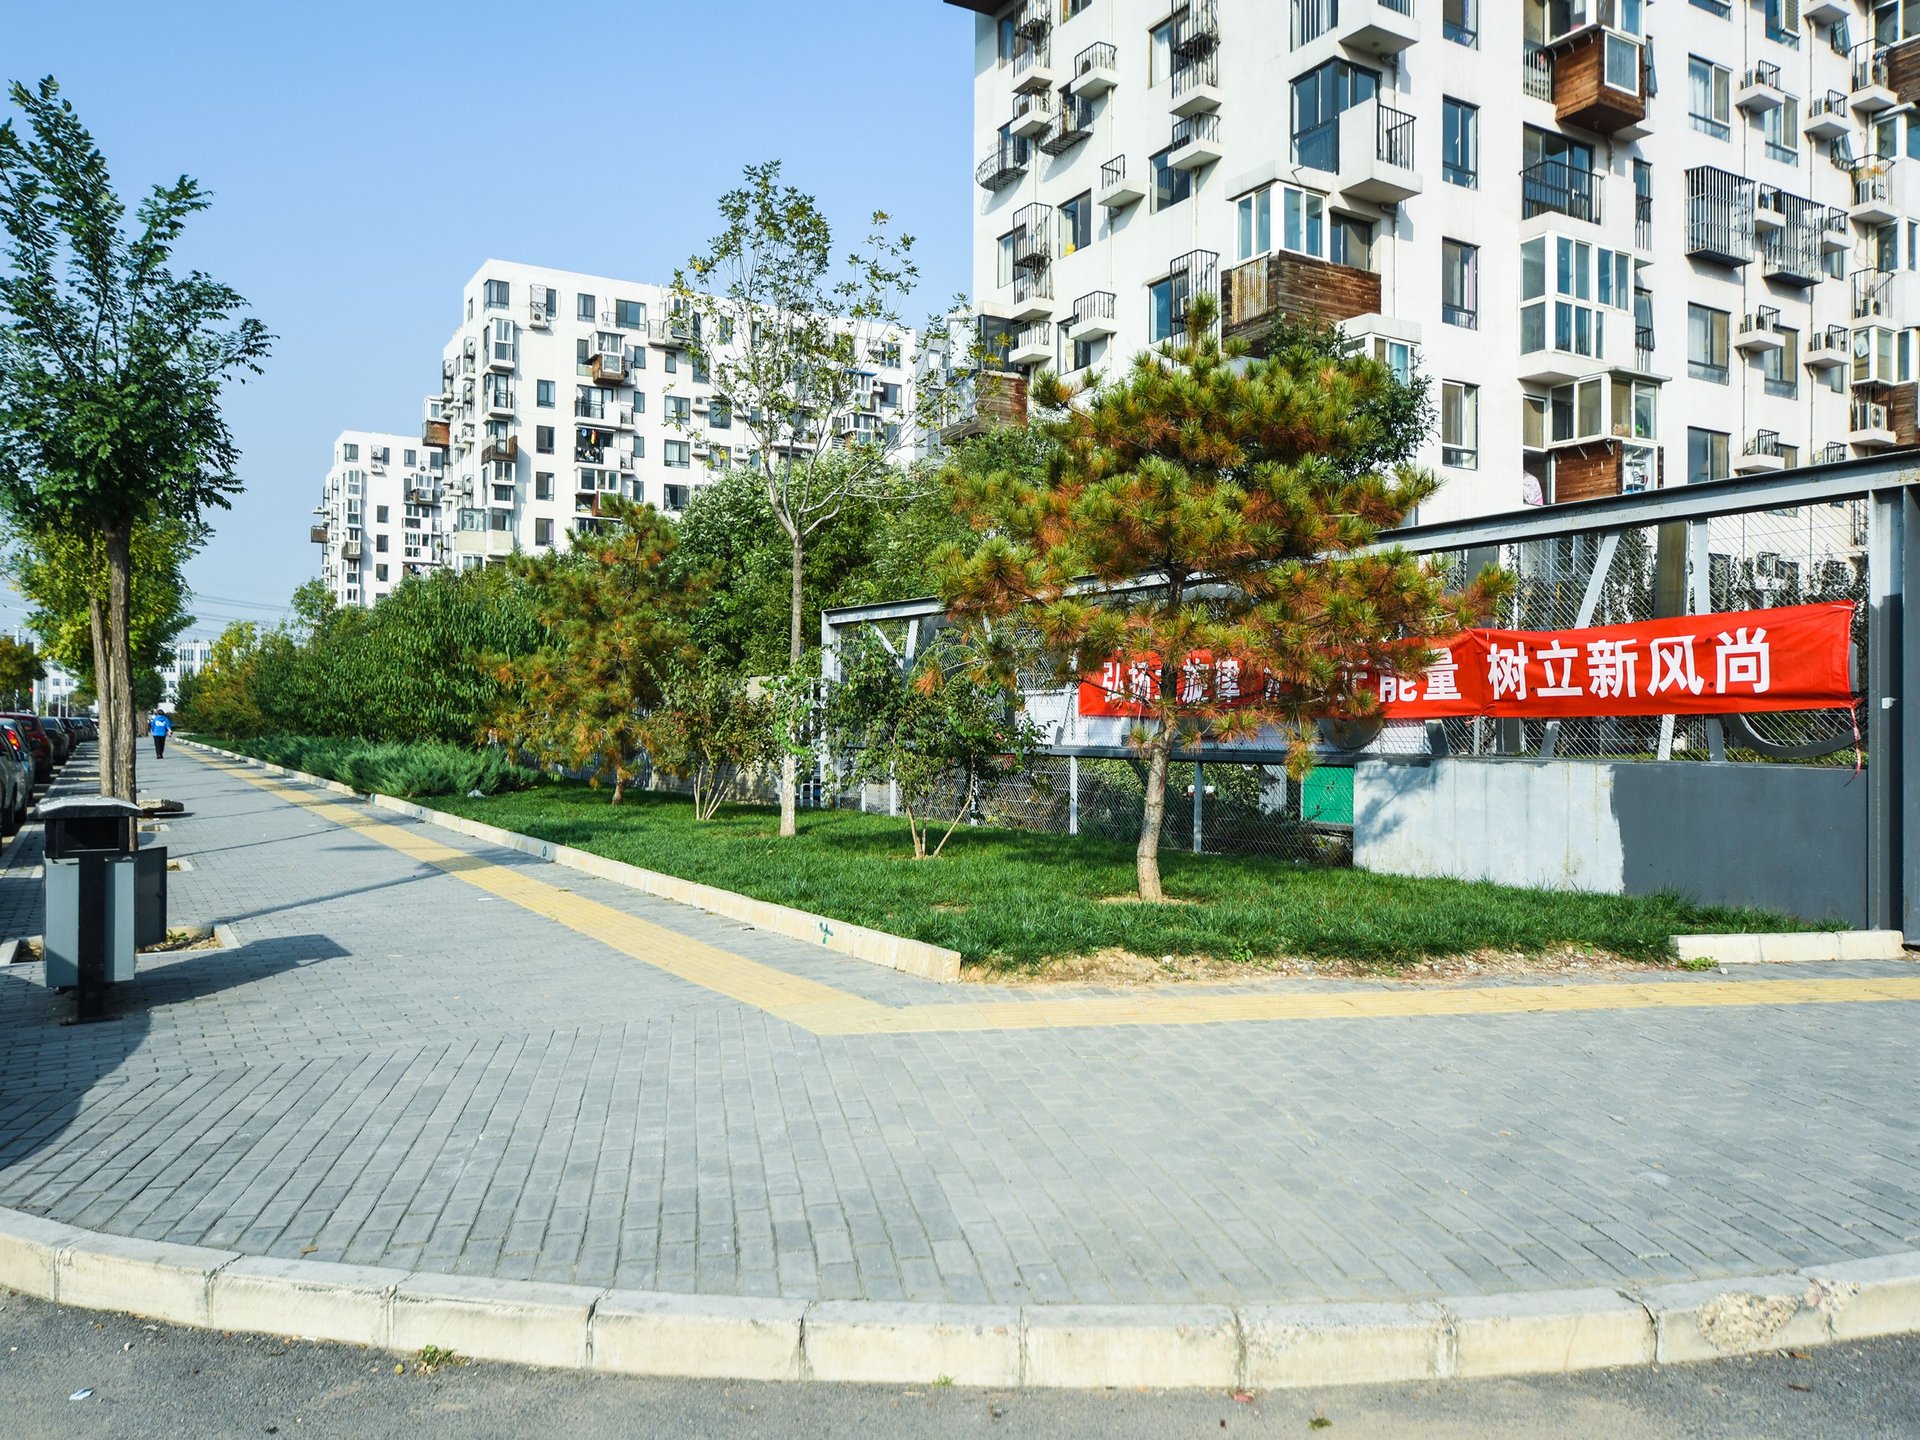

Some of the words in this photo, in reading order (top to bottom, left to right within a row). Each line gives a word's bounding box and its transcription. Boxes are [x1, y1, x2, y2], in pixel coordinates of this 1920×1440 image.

[1487, 627, 1771, 701] 树立新风尚
